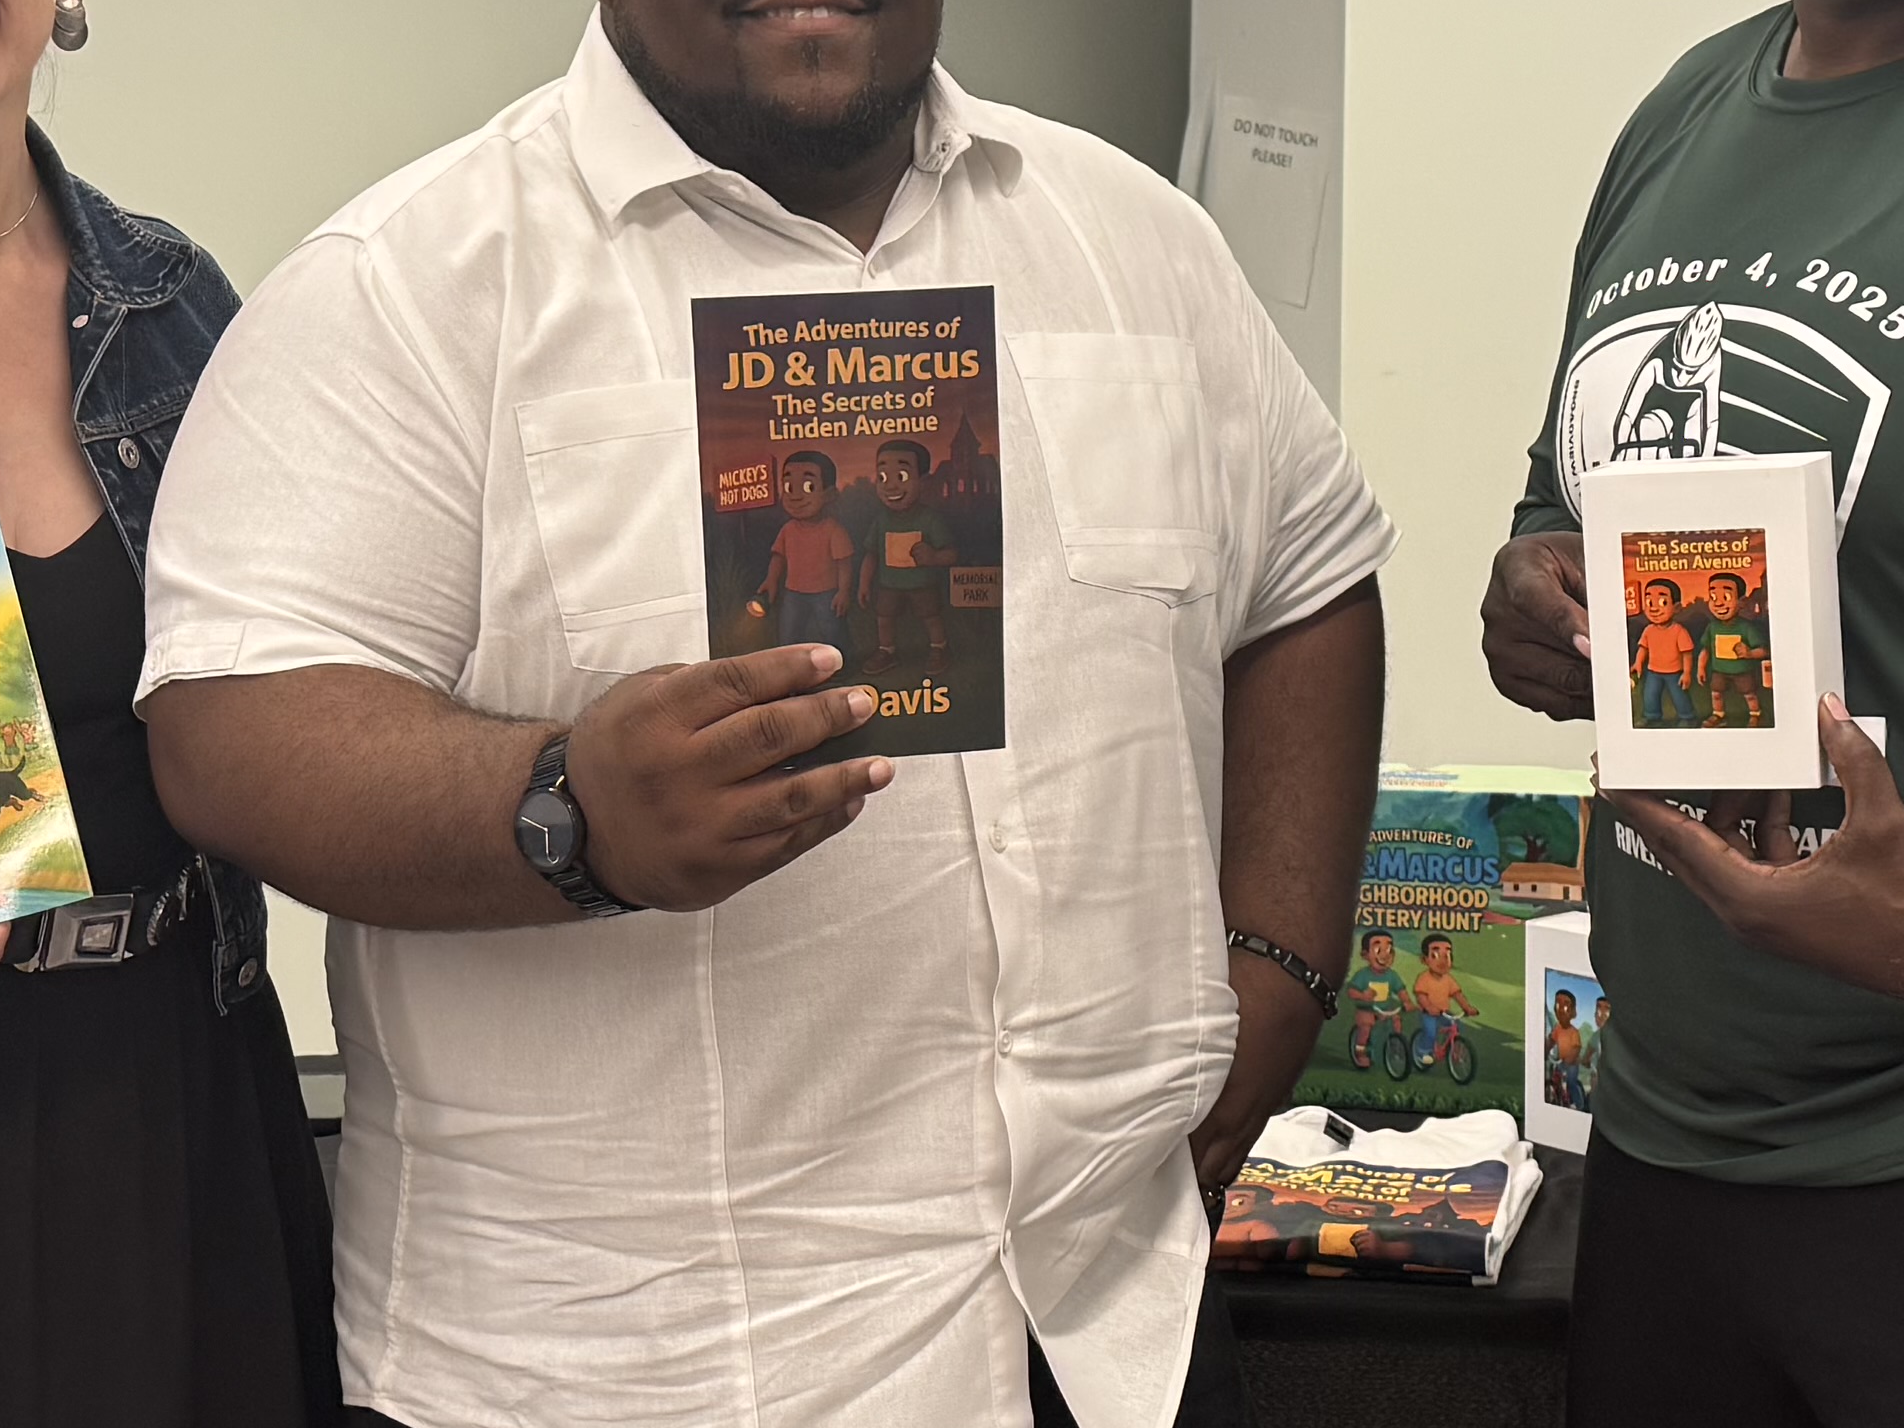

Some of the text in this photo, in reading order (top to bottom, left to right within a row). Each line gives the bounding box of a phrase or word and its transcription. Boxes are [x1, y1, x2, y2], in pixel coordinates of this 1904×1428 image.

[1234, 118, 1318, 147] DO NOT TOUCH
[1586, 257, 1728, 319] October
[1745, 252, 1778, 288] 4,
[743, 316, 962, 347] The Adventures of
[722, 346, 980, 390] JD & Marcus
[772, 386, 935, 416] The Secrets of
[769, 414, 938, 441] Linden Avenue
[719, 465, 767, 489] MICKEY'S
[720, 483, 769, 506] HOT DOGS
[1638, 537, 1749, 555] The Secrets of
[1636, 554, 1752, 572] Linden Avenue
[1369, 829, 1474, 850] ADVENTURES OF
[1377, 847, 1500, 885] MARCUS
[1360, 884, 1489, 908] GHBORHOOD
[1355, 907, 1482, 931] STERY HUNT
